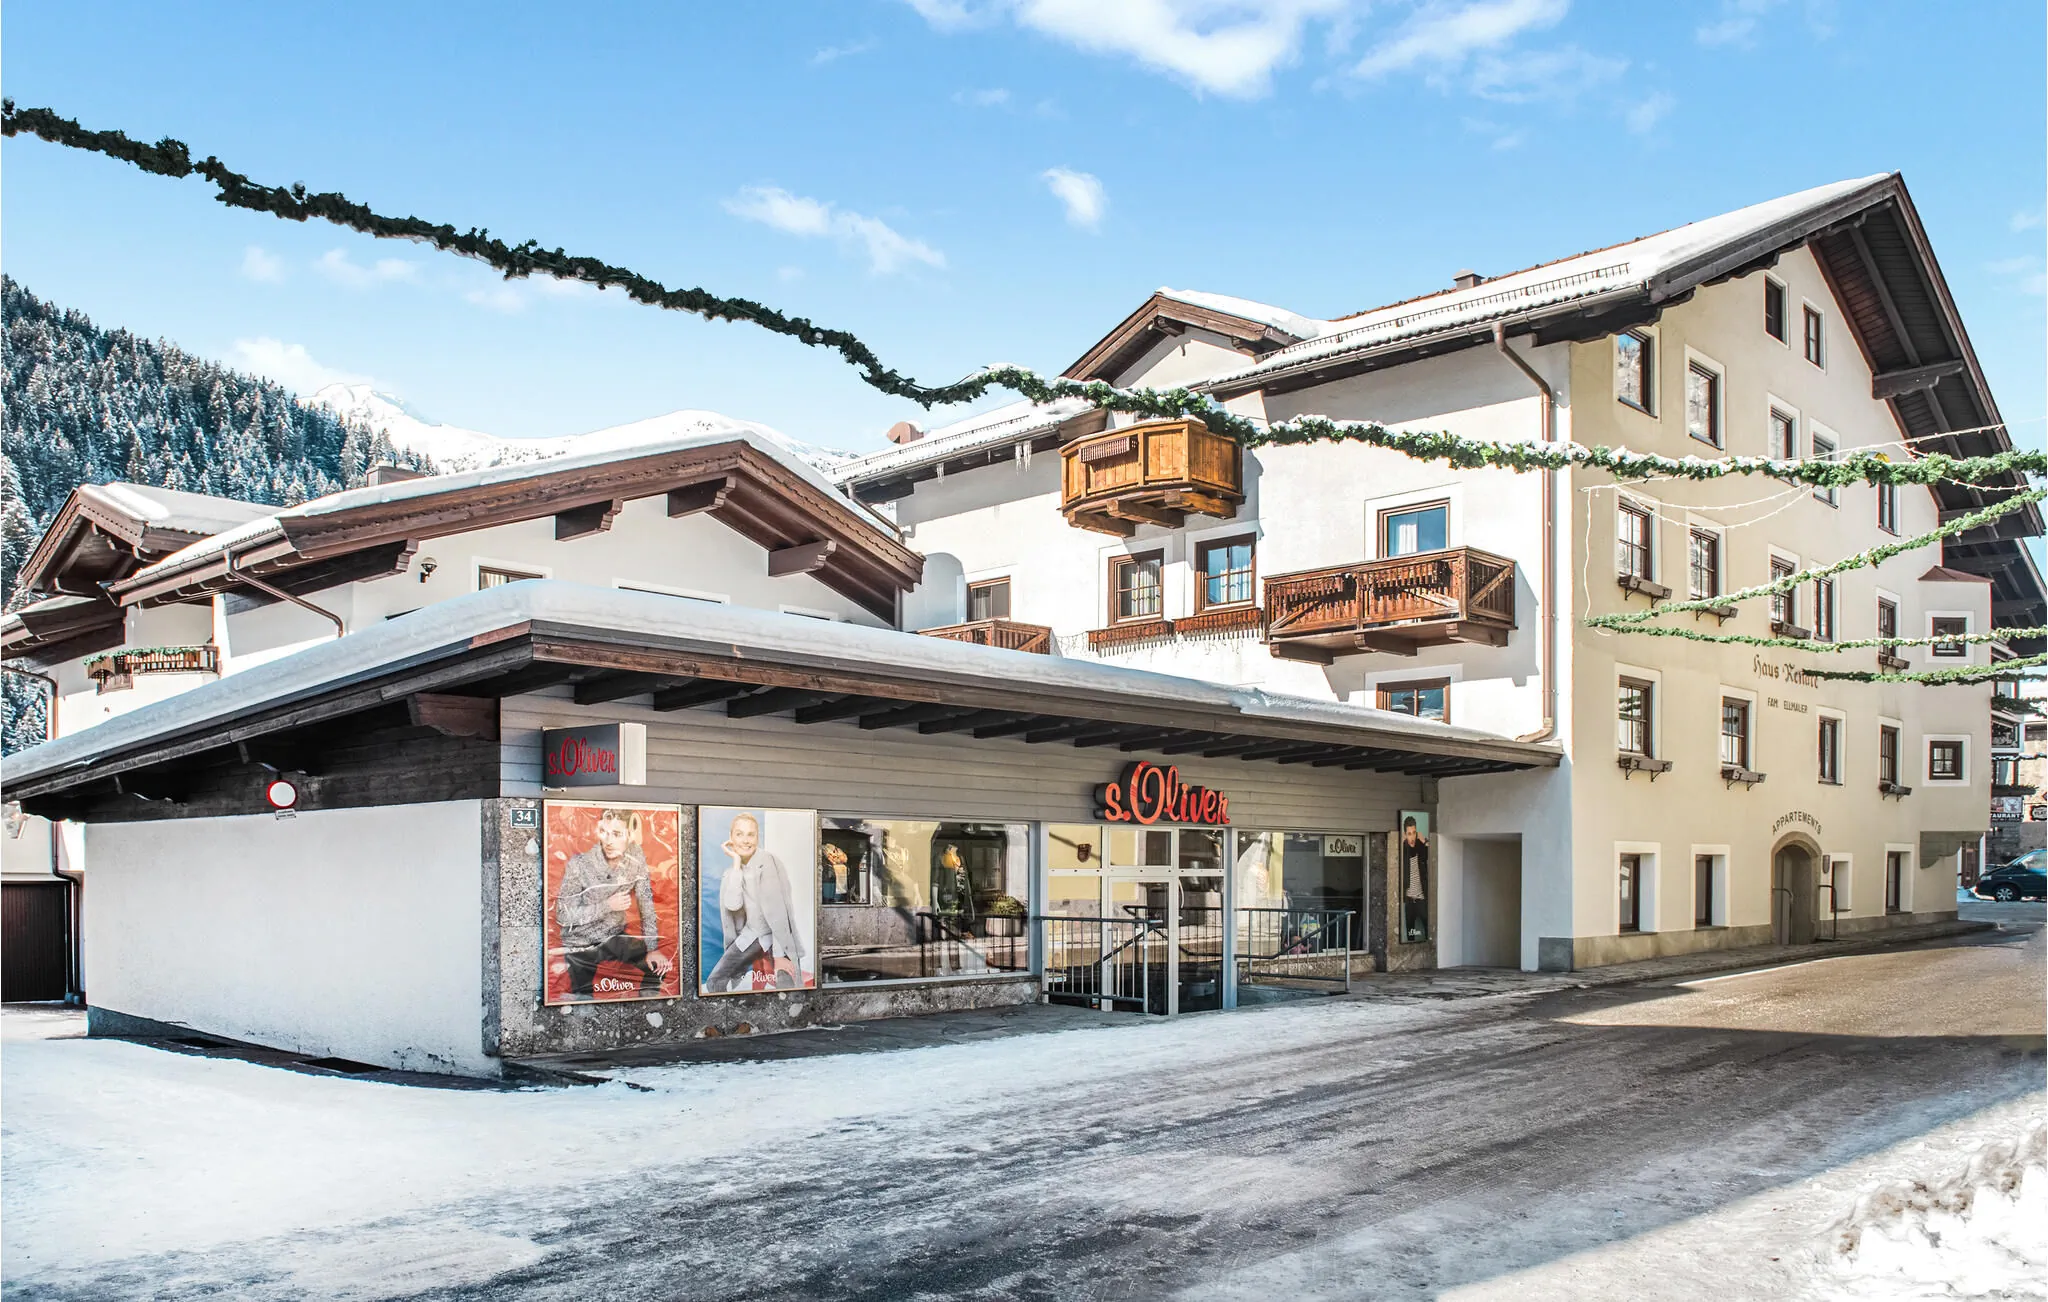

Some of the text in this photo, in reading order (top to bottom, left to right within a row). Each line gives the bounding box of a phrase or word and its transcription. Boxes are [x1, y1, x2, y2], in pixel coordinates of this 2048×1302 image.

[1753, 654, 1779, 679] Haus
[549, 736, 617, 777] s.Oliver
[1104, 760, 1230, 825] s.Oliver
[516, 810, 532, 822] 34
[1772, 811, 1822, 835] APPARTEMENTS
[1329, 838, 1356, 853] s.Oliver
[593, 977, 636, 992] s.Oliver
